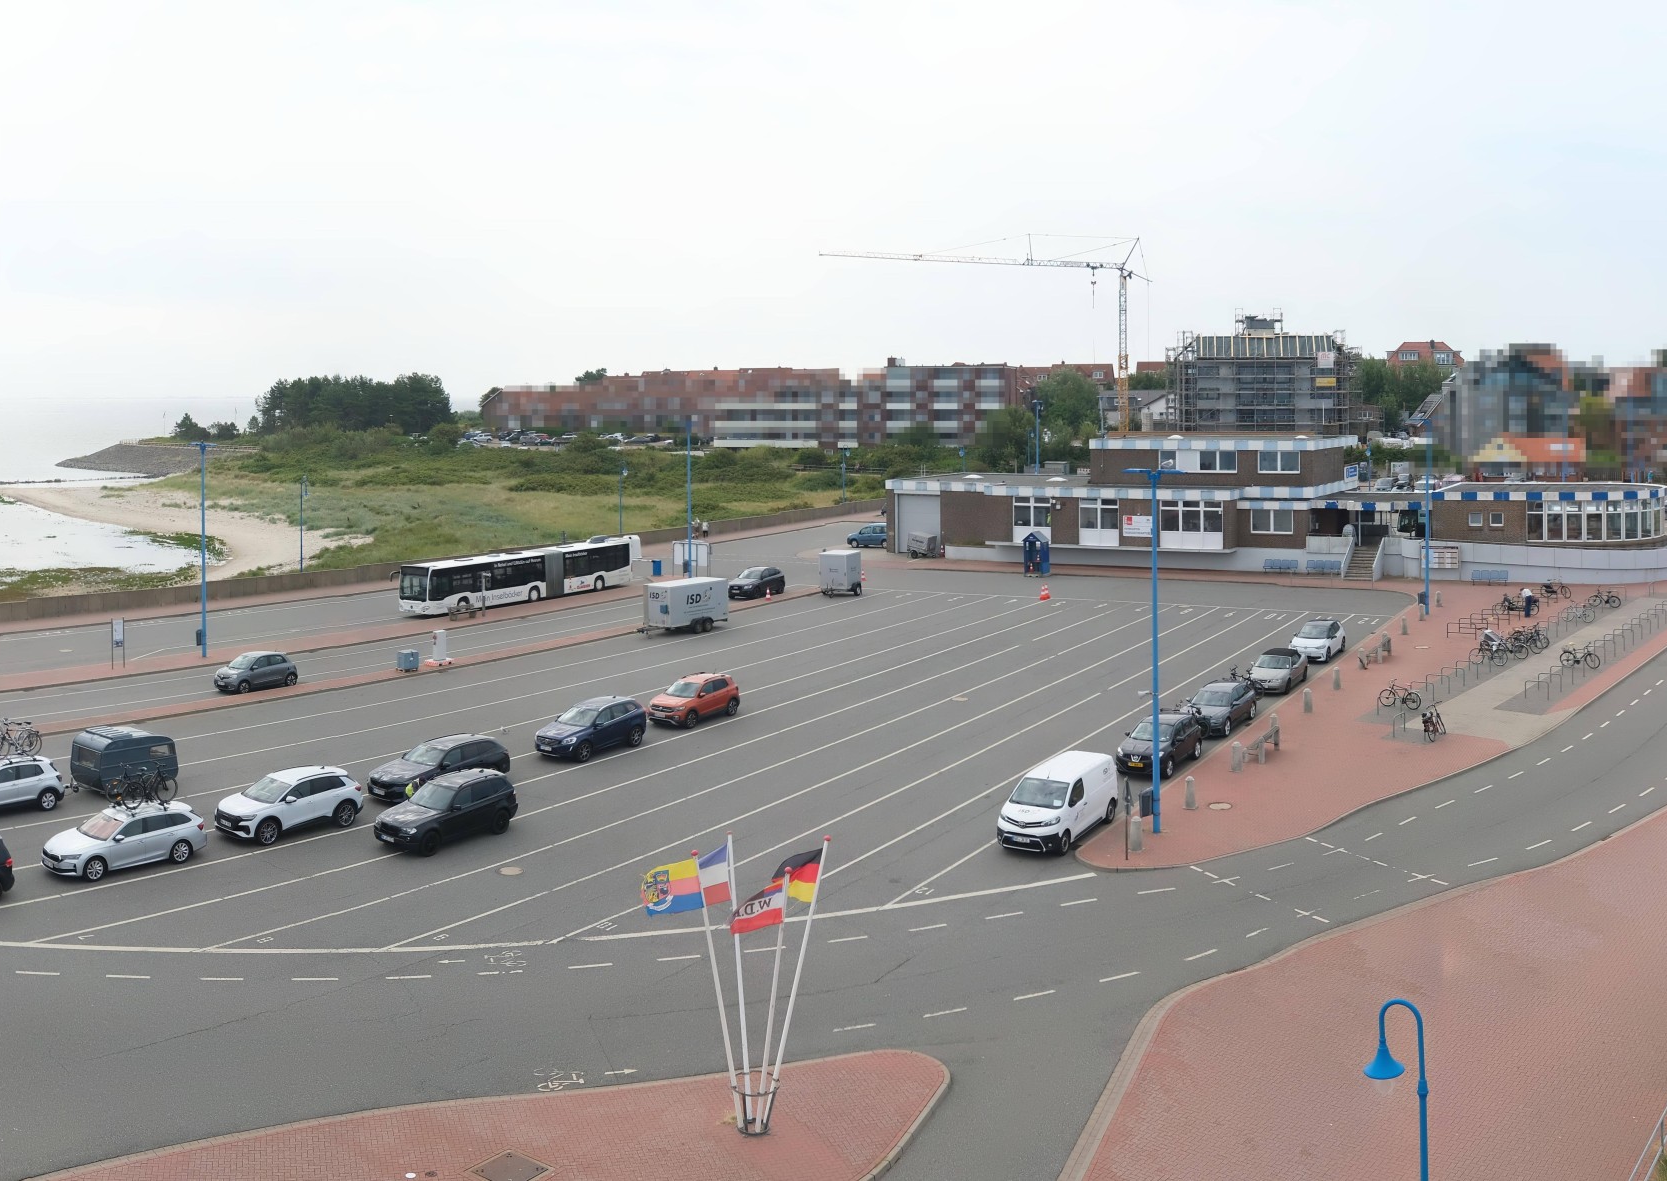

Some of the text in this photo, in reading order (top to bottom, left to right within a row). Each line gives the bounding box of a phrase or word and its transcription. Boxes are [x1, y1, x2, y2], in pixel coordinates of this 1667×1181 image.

[475, 594, 491, 603] Min
[649, 591, 660, 600] ISD
[686, 592, 702, 606] ISD
[914, 886, 935, 896] 12
